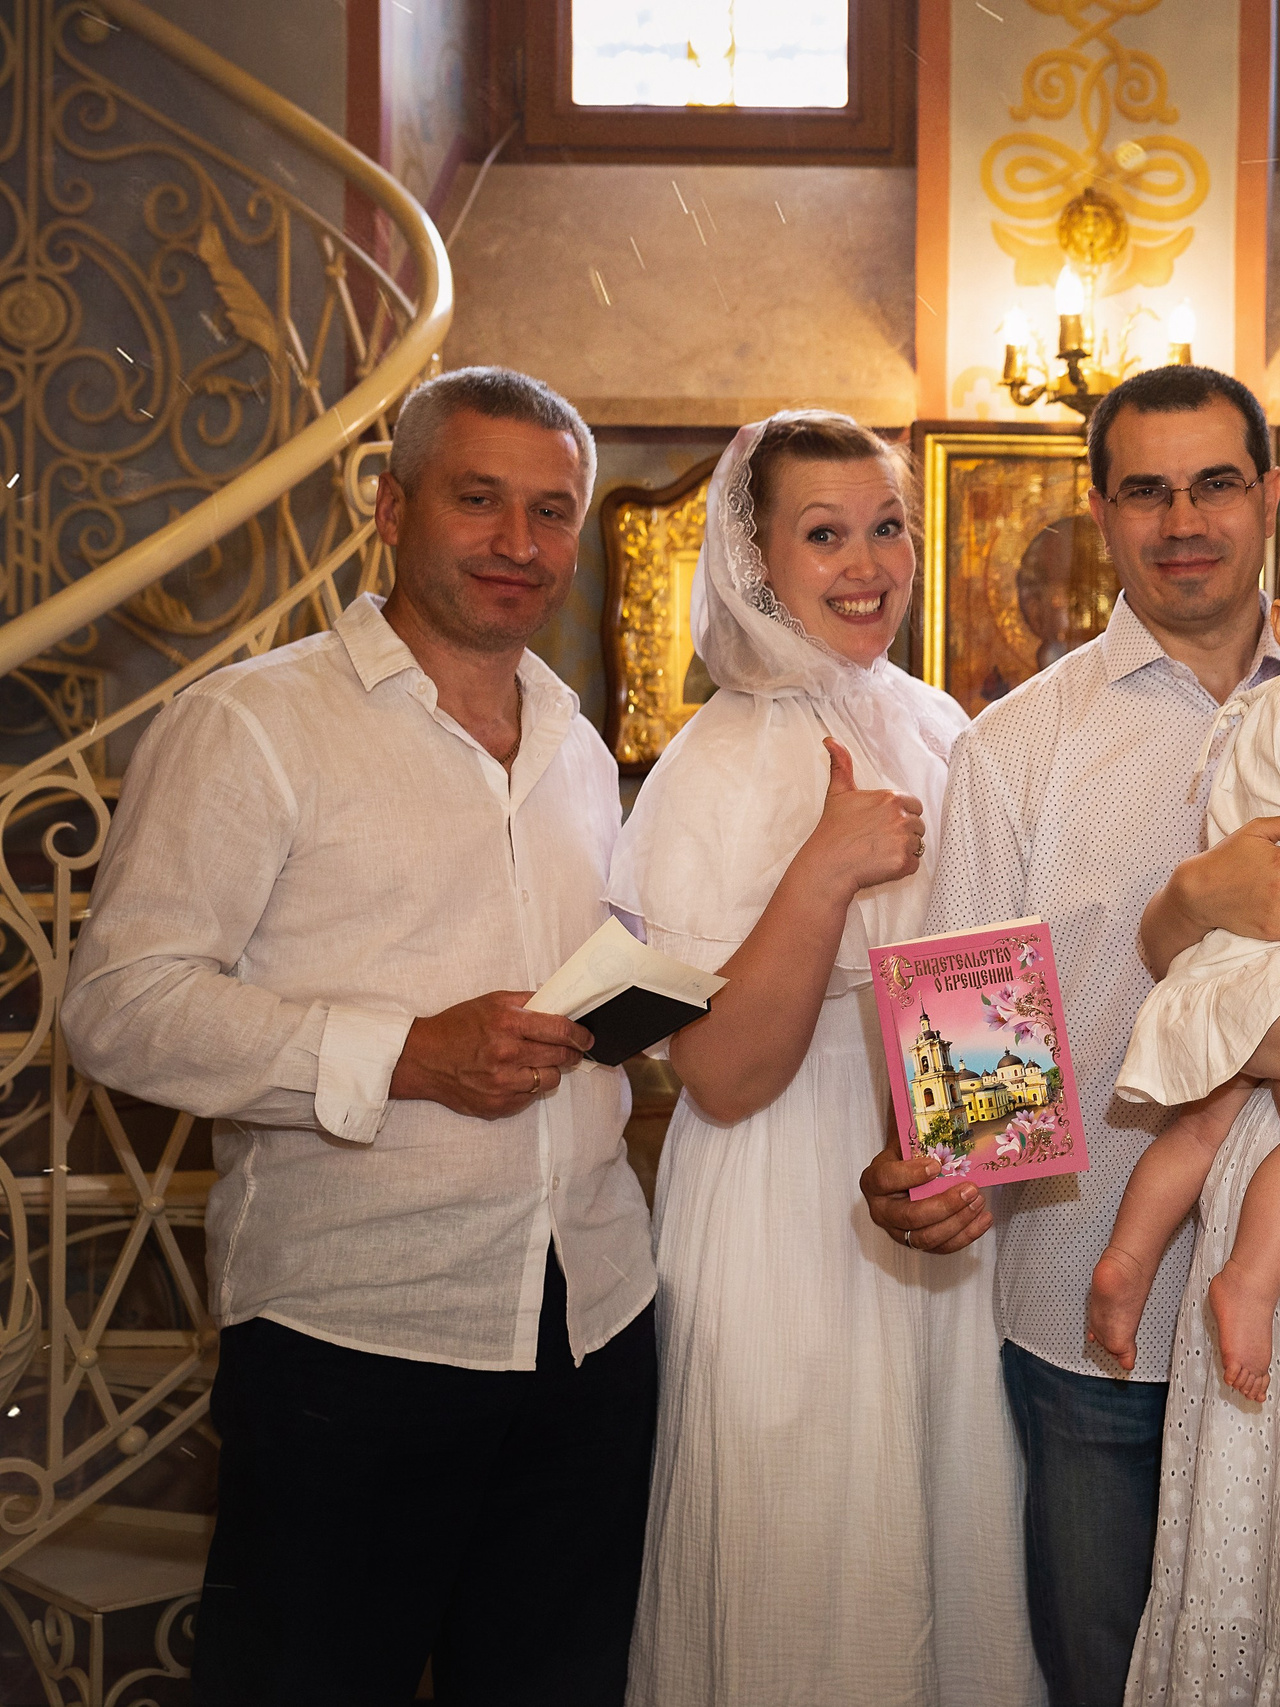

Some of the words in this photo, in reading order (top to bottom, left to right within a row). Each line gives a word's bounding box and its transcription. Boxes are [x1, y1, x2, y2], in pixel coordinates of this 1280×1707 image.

[893, 947, 1011, 990] СВИДЕТЕЛЬСТВО
[935, 978, 943, 993] О
[946, 966, 1013, 992] КРЕЩЕНИИ
